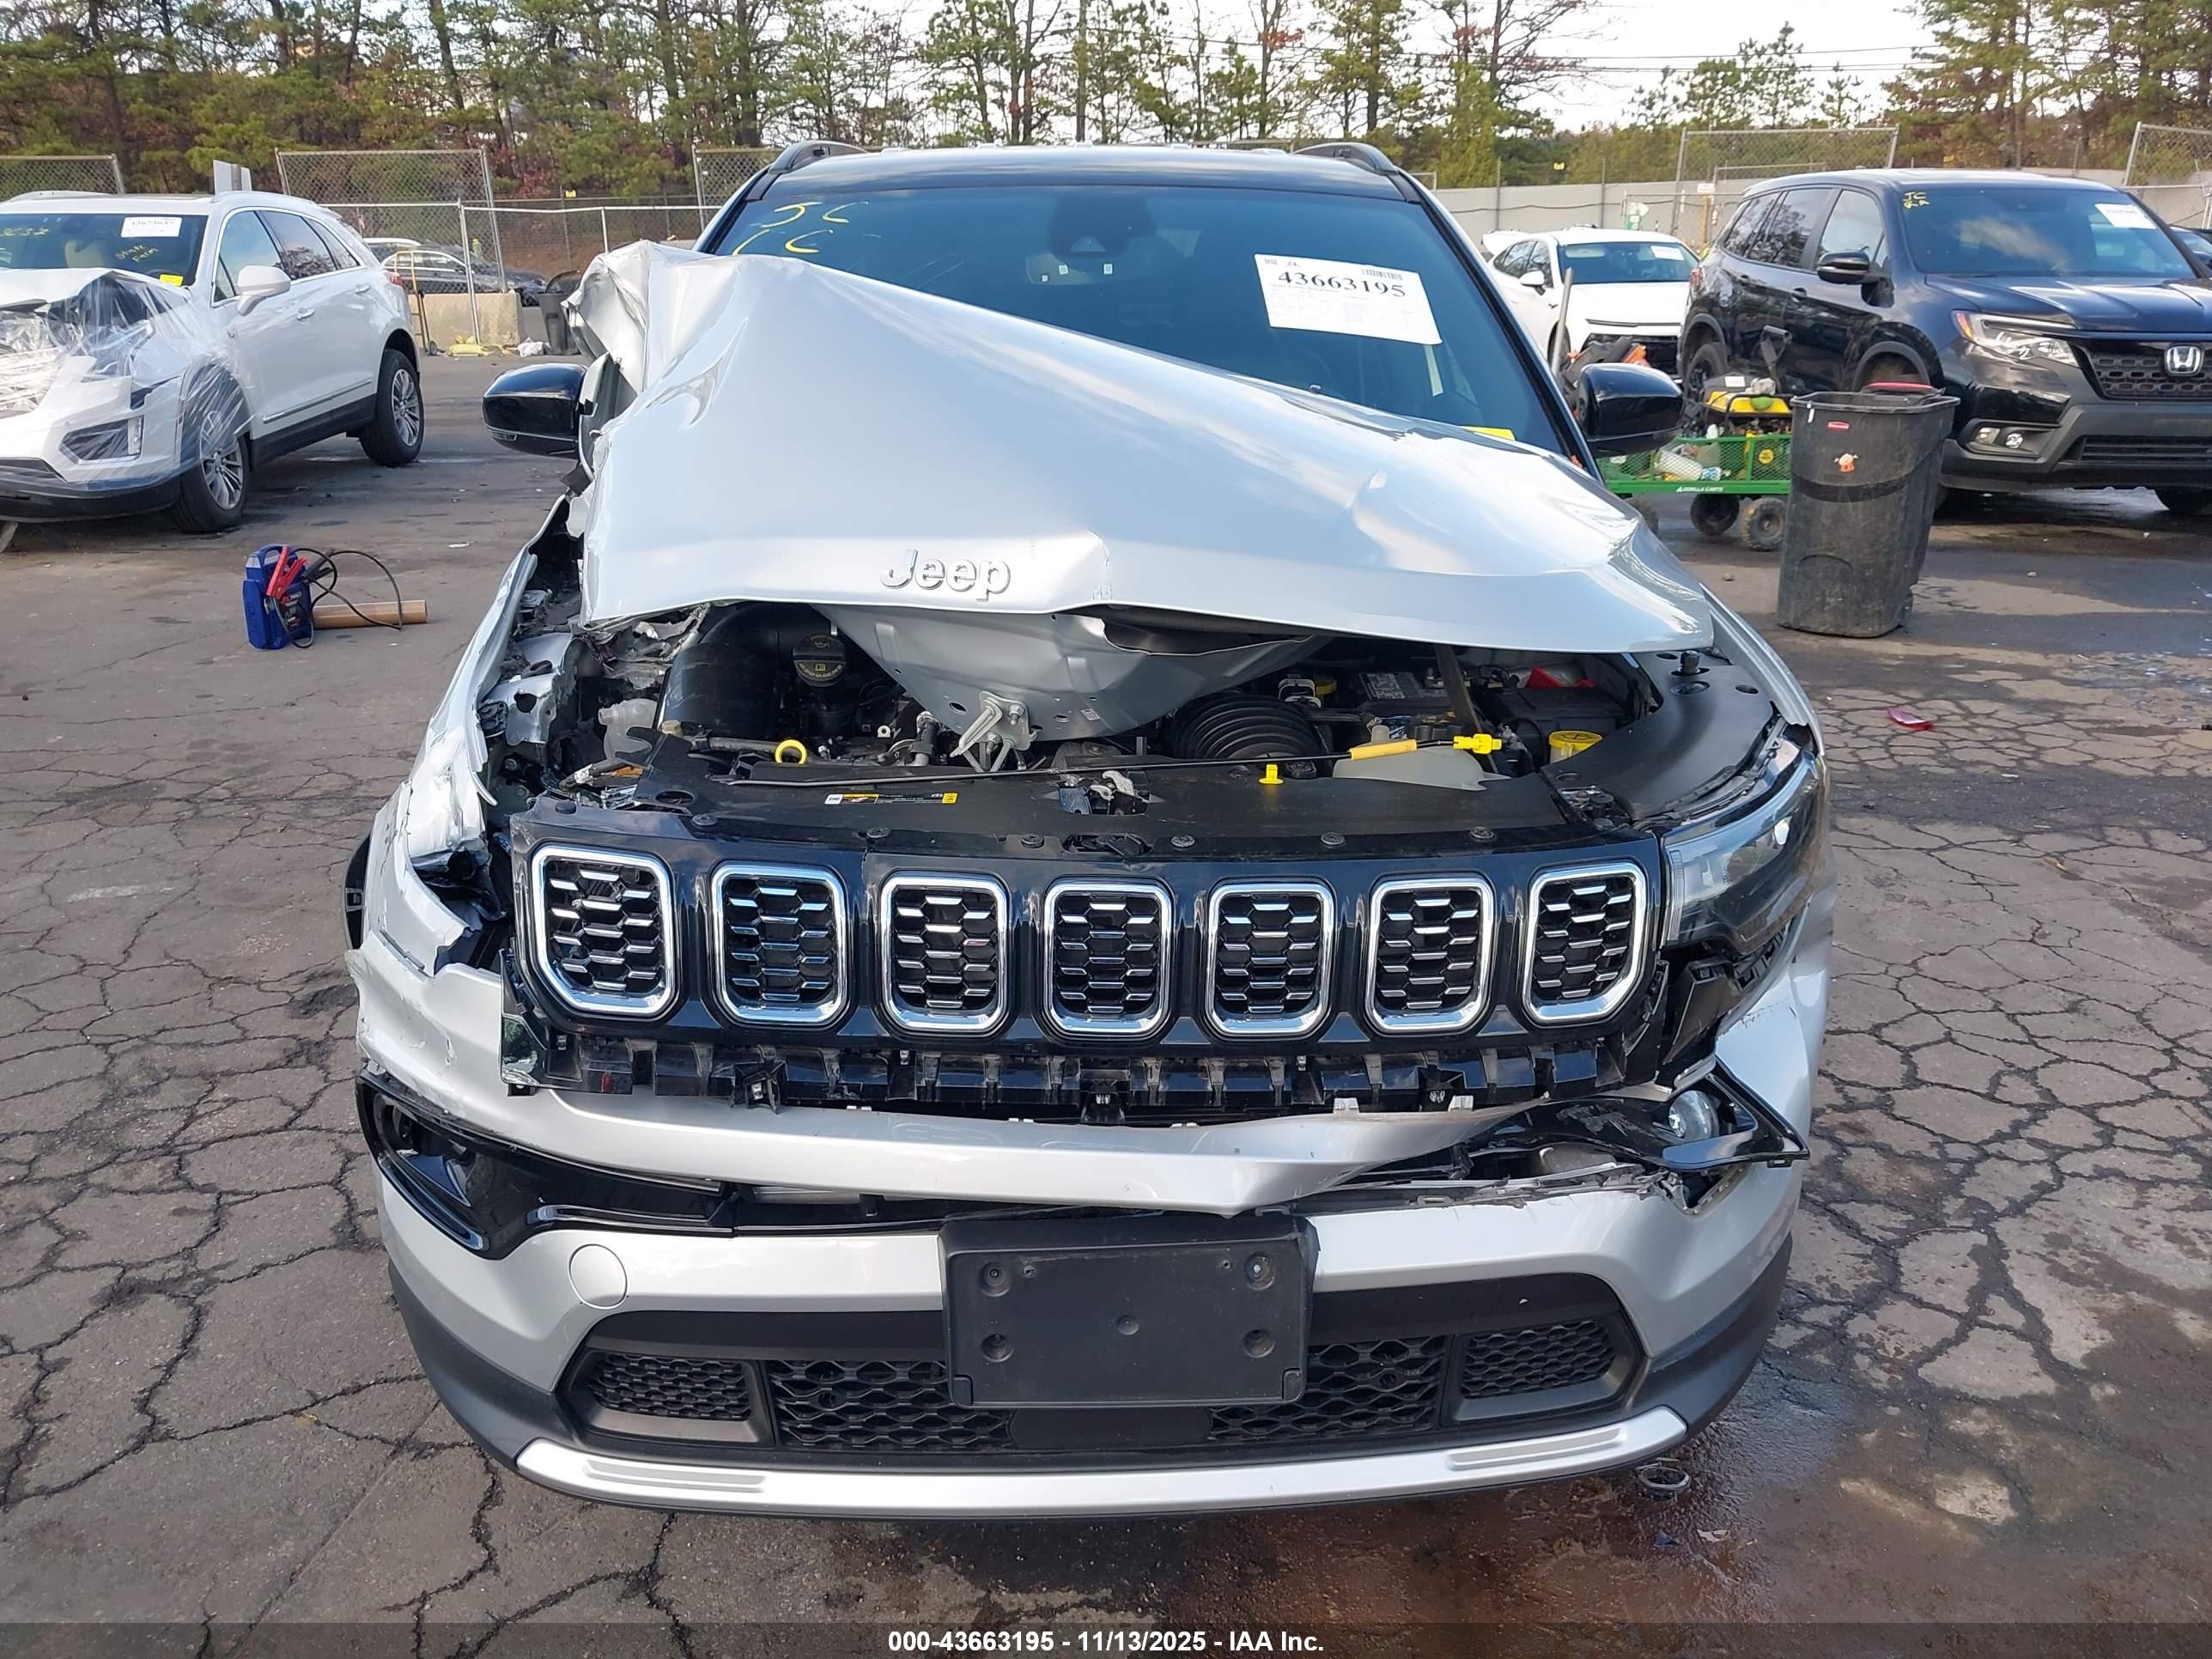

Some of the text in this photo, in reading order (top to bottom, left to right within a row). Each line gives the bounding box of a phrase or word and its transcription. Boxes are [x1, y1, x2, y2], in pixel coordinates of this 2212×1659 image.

[131, 247, 159, 263] Farm
[1278, 270, 1406, 298] 43663195
[880, 550, 1012, 602] Jeep
